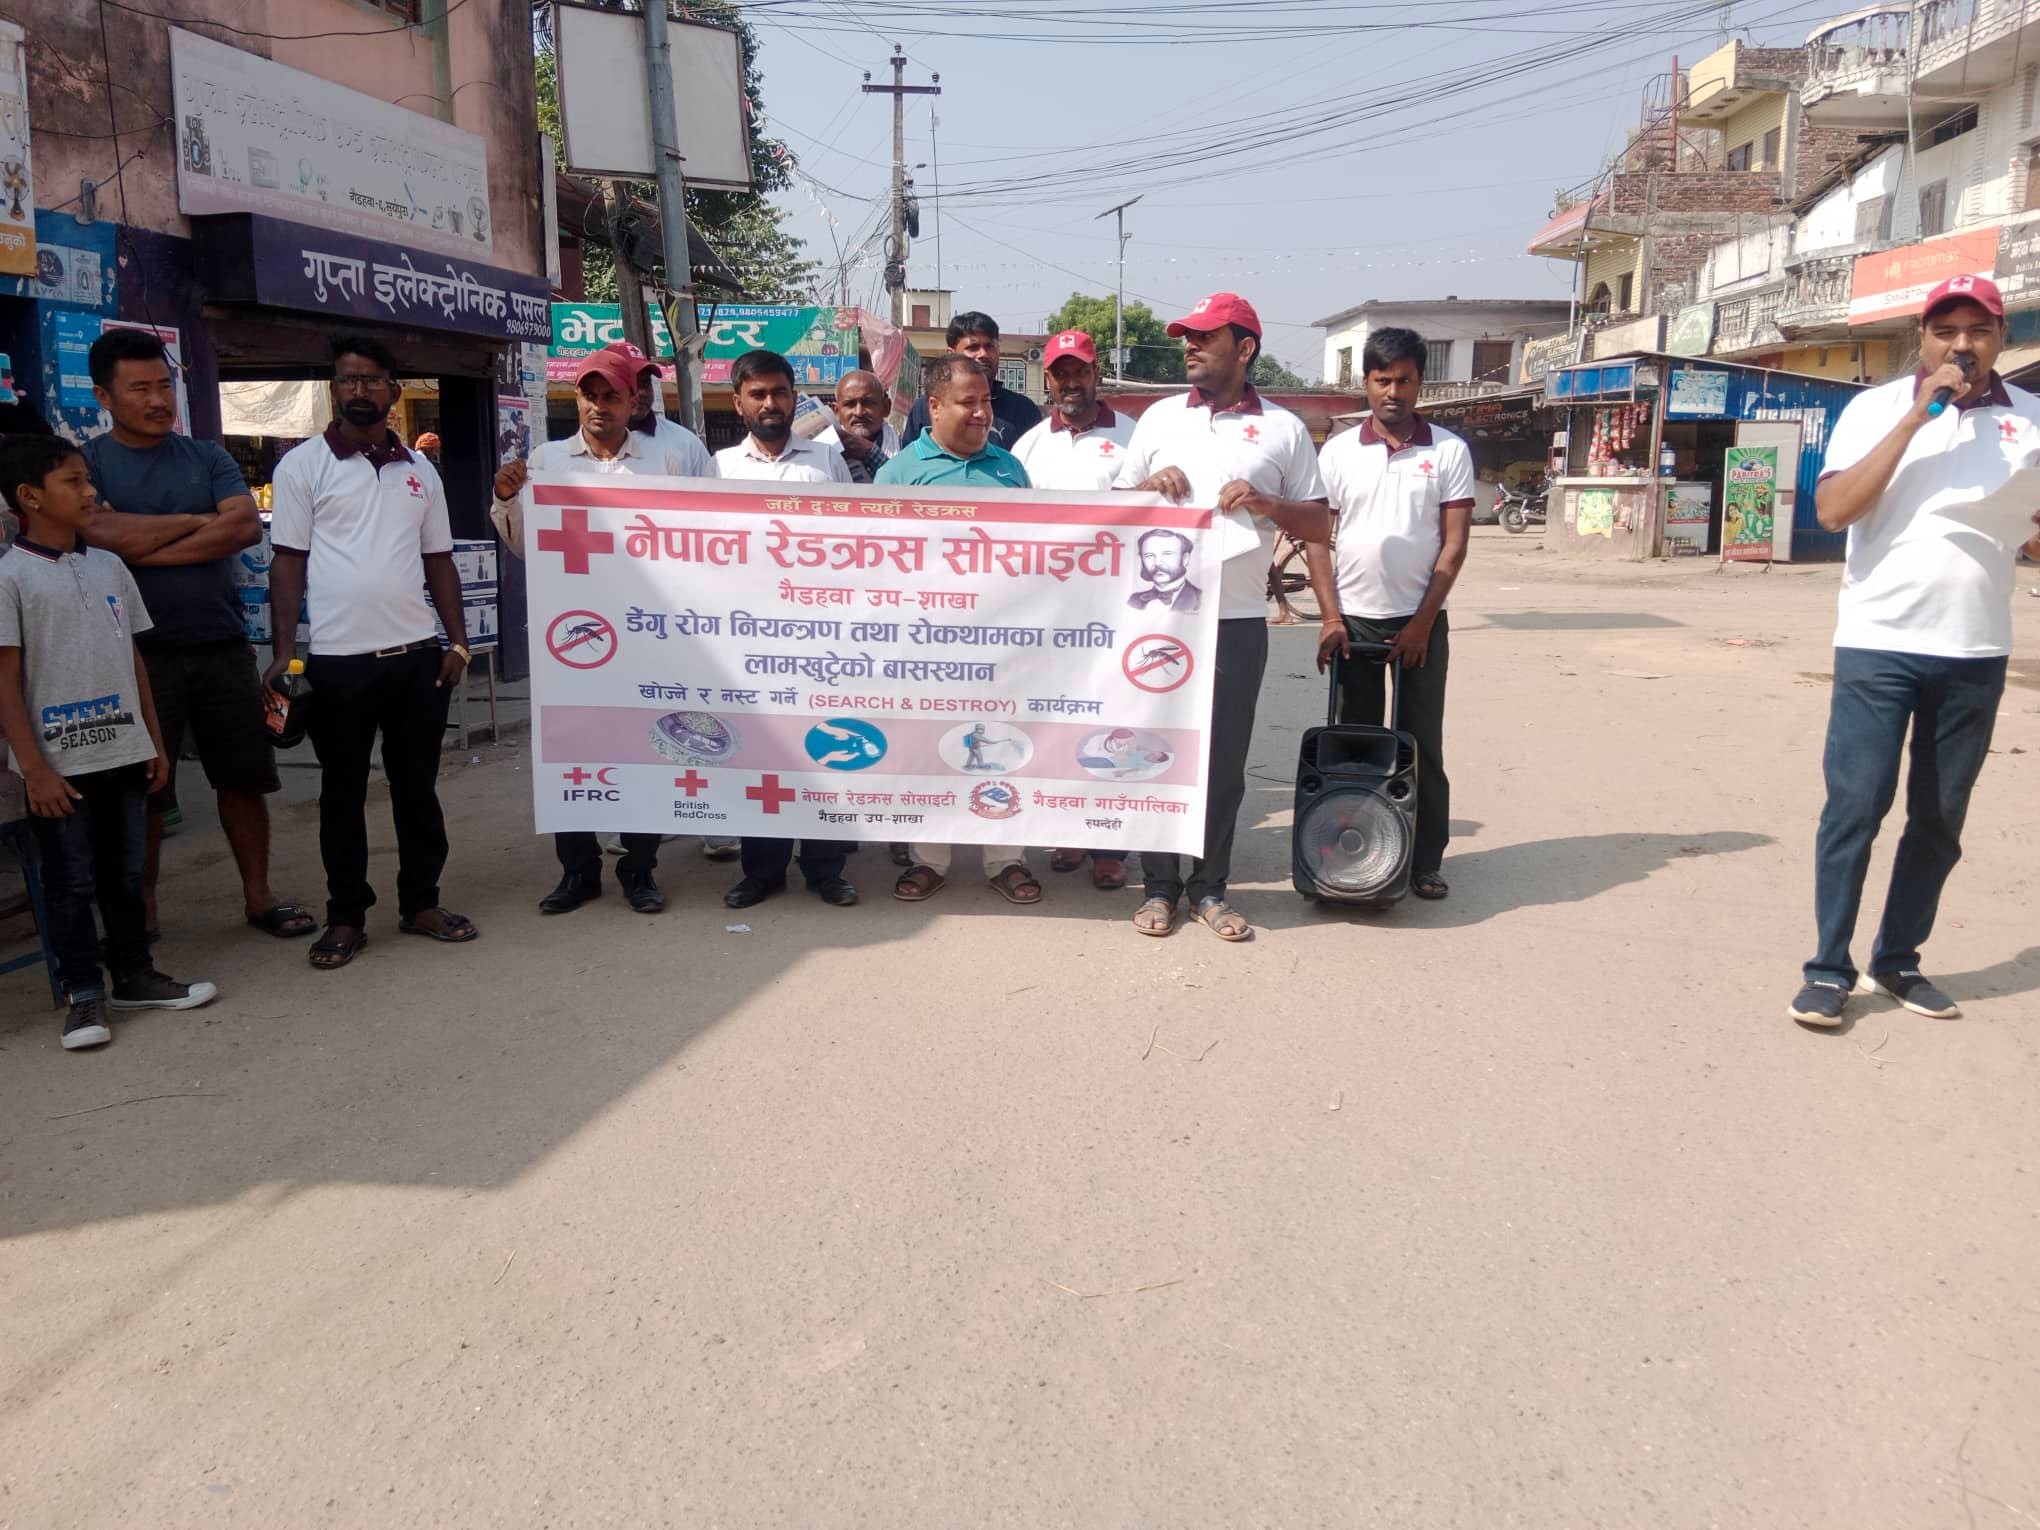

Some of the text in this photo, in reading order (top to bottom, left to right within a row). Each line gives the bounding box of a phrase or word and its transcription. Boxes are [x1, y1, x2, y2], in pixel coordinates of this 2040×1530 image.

[302, 250, 547, 324] गुप्ता इलेक्ट्रोनिक पसल
[765, 495, 801, 512] जहाँ
[861, 498, 903, 518] त्यहाँ
[912, 502, 978, 519] रेडक्रस
[624, 514, 1125, 583] नेपाल रेडक्रस सोसाइटी
[779, 579, 979, 610] गैडहवा उप-शाखा
[675, 608, 722, 636] रोग
[730, 609, 841, 642] नियन्त्रण
[850, 621, 900, 645] तथा
[908, 617, 1044, 650] रोकथामका
[1053, 622, 1116, 650] लागि
[744, 650, 996, 687] लामखुट्टेको बासस्थान
[638, 681, 1104, 716] खोज्ने र नस्ट गर्ने (SEARCH & DESTROY) कार्यक्रम
[42, 692, 135, 742] STEEL
[60, 727, 117, 750] SEASON
[563, 789, 621, 802] IFRC
[674, 799, 711, 811] British
[802, 788, 957, 808] नेपाल रेडक्रस सोसाइटी
[1032, 790, 1188, 816] गैडहवा गाउँपालिका
[674, 810, 728, 821] RedCross
[864, 813, 925, 826] उप-शाखा
